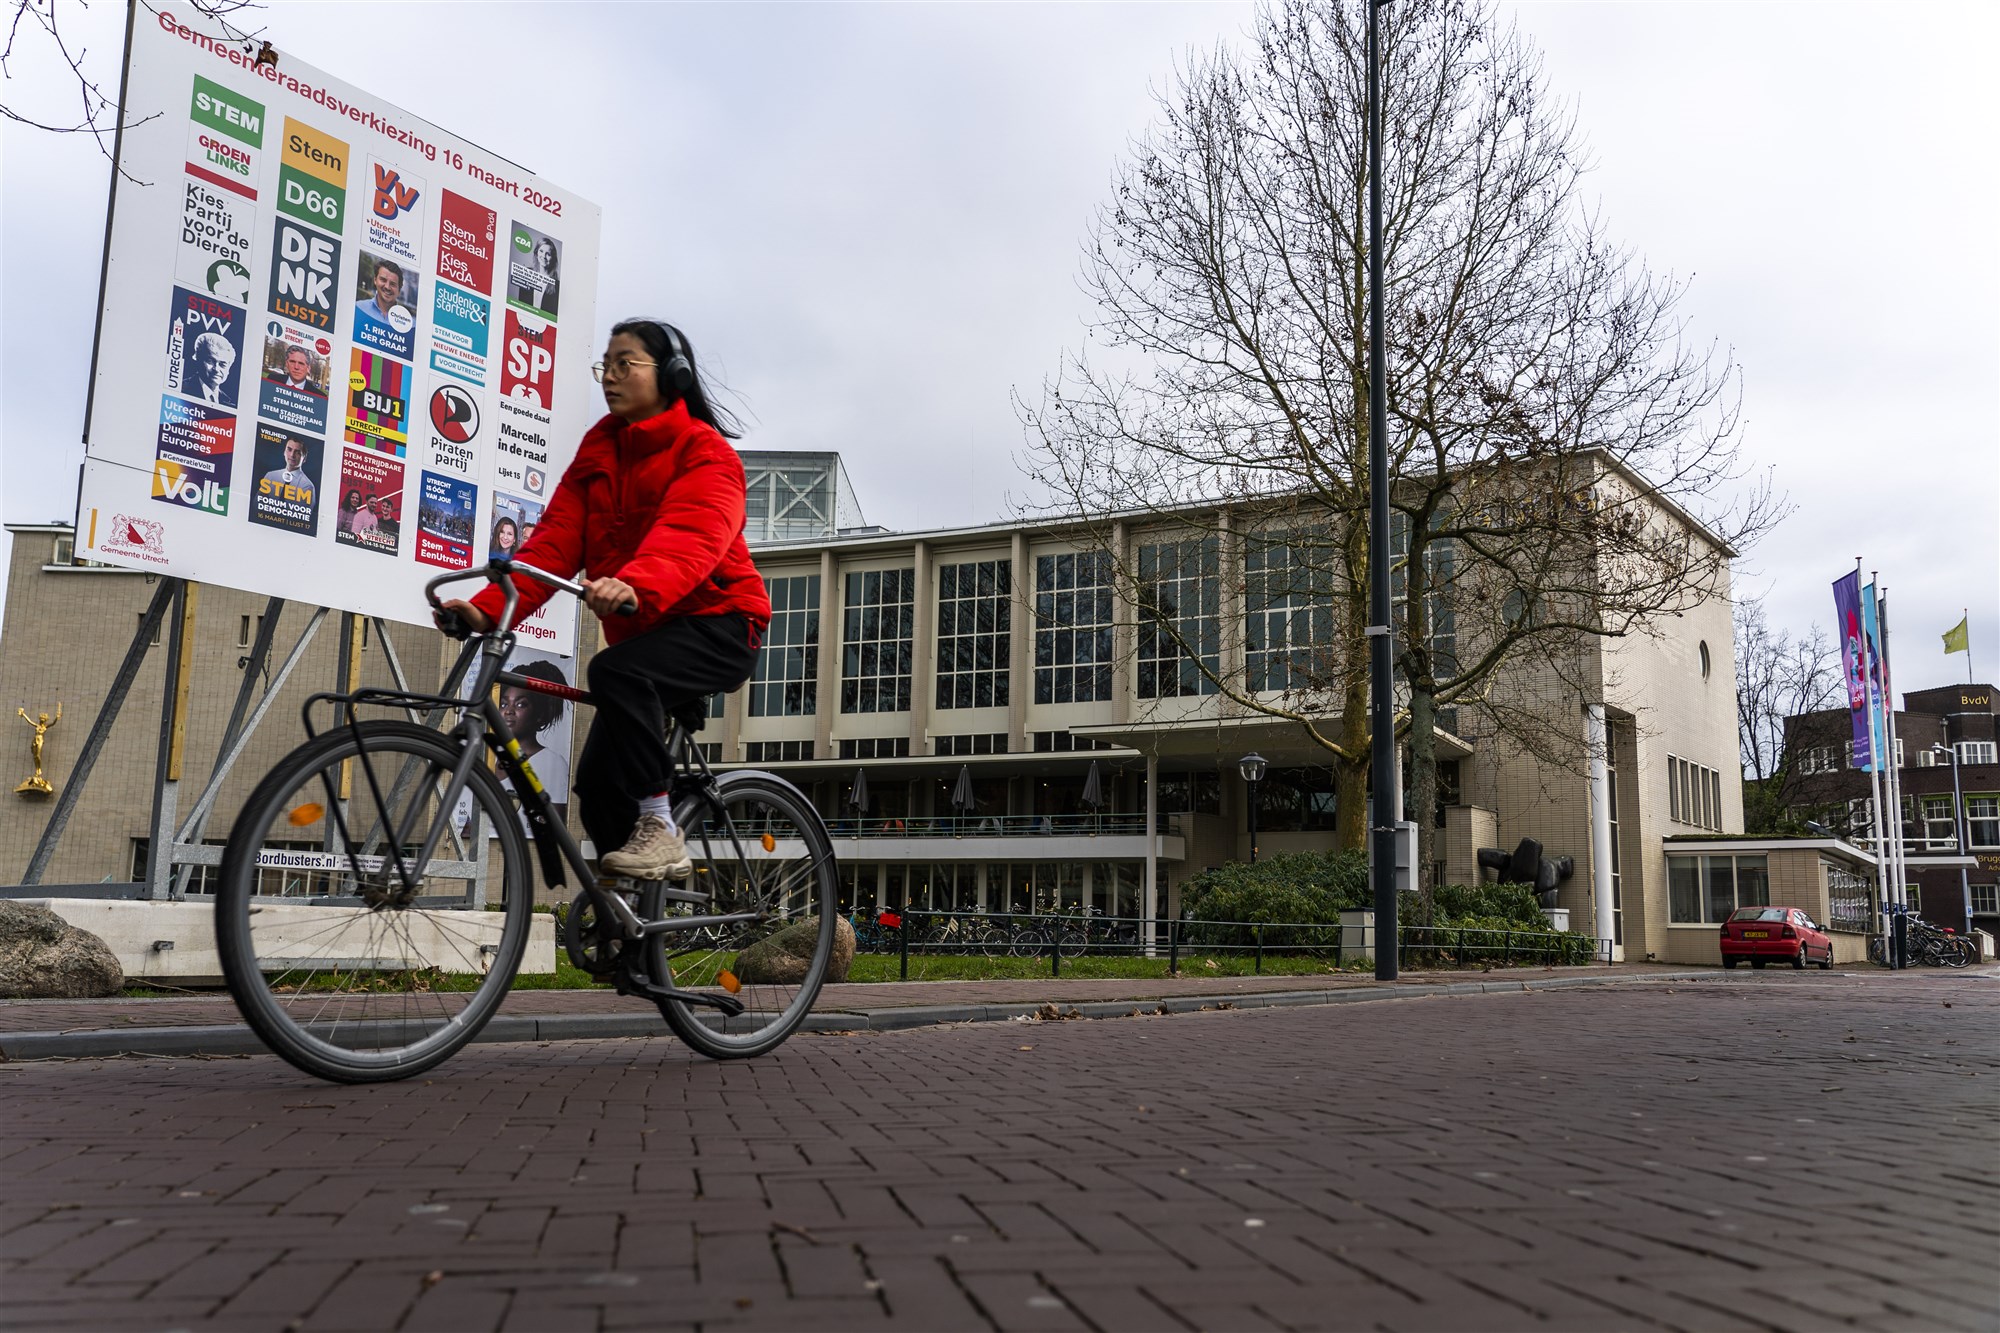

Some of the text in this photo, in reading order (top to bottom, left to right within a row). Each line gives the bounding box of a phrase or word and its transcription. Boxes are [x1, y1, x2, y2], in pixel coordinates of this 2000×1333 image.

[158, 11, 562, 218] Gemeenteraadsverkiezing 16 maart 2022
[195, 92, 260, 134] STEM
[198, 135, 251, 165] GROEN
[289, 135, 341, 172] Stem
[206, 149, 249, 176] LINKS
[186, 183, 224, 210] Kies
[285, 179, 338, 220] D66
[185, 198, 232, 231] Partij
[487, 212, 495, 232] PvdA
[183, 216, 249, 250] voor de
[369, 227, 410, 249] blijft goed
[370, 218, 401, 237] Utrecht
[443, 219, 476, 243] Stem
[182, 228, 240, 262] Dieren
[369, 236, 417, 260] wordt beter.
[442, 233, 489, 260] sociaal.
[515, 236, 531, 249] CDA
[441, 250, 468, 272] Kies
[440, 261, 477, 287] PvdA.
[188, 295, 232, 321] STEM
[436, 297, 470, 319] starter
[437, 288, 473, 311] student
[186, 308, 232, 336] PVV
[275, 298, 329, 327] LIJST 7
[360, 331, 408, 353] DER GRAAF
[364, 323, 406, 344] 1. RIK VAN
[434, 327, 469, 345] STEM VOOR
[518, 324, 543, 344] STEM
[168, 337, 183, 388] UTRECHT
[433, 341, 485, 365] NIEUWE ENERGIE
[507, 337, 552, 384] SP
[439, 358, 484, 379] VOOR UTRECHT
[273, 396, 315, 414] STEM LOKAAL
[275, 386, 314, 404] STEM WIJZER
[363, 391, 402, 418] BIJ1
[164, 399, 206, 420] Utrecht
[262, 404, 323, 427] STEM STADSBELANG
[279, 414, 307, 427] UTRECHT
[500, 401, 550, 424] Een goede daad
[162, 421, 216, 445] Duurzaam
[164, 411, 233, 438] Vernieuwend
[261, 428, 287, 440] VRIJHEID
[350, 419, 382, 434] UTRECHT
[501, 422, 546, 447] Marcello
[161, 433, 212, 455] Europees
[260, 433, 282, 444] TERUG!
[431, 436, 474, 460] Piraten
[162, 452, 212, 471] #GeneratieVolt
[344, 450, 402, 473] STEM STRIJDBARE
[498, 438, 547, 464] in de raad
[343, 459, 387, 476] SOCIALISTEN
[435, 453, 468, 473] partij
[498, 467, 521, 480] Lijst 15
[342, 468, 352, 476] DE
[353, 470, 373, 481] RAAD
[426, 477, 452, 489] UTRECHT
[158, 467, 225, 511] Volt
[259, 478, 312, 505] STEM
[425, 492, 452, 504] VAN JOU!
[257, 495, 312, 515] FORUM VOOR
[257, 503, 310, 522] DEMOCRATIE
[264, 515, 285, 524] MAART
[289, 520, 304, 528] LIJST
[337, 531, 355, 540] STEM
[366, 534, 395, 546] UTRECHT
[421, 538, 443, 551] Stem
[100, 545, 169, 565] Gemeente Utrecht
[420, 549, 467, 567] EenUtrecht
[1961, 695, 1989, 705] BvdV
